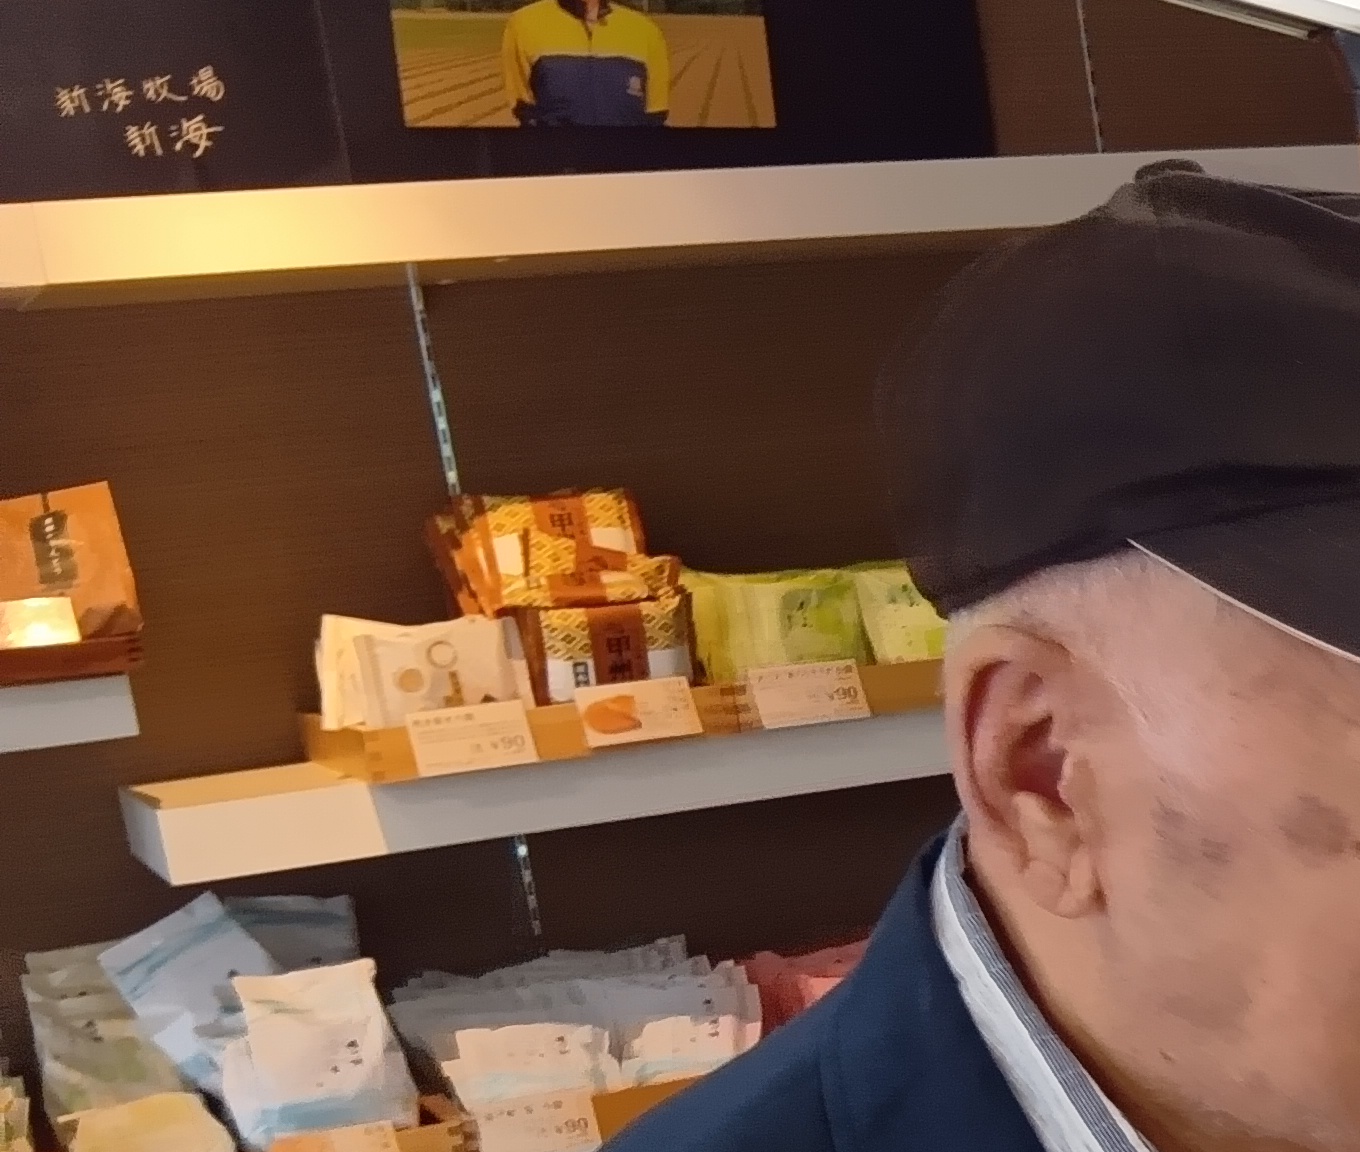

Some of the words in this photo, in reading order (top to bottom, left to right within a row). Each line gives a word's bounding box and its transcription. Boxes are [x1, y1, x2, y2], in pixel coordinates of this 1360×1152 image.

[55, 65, 226, 117] 新海牧場
[125, 114, 224, 158] 新海
